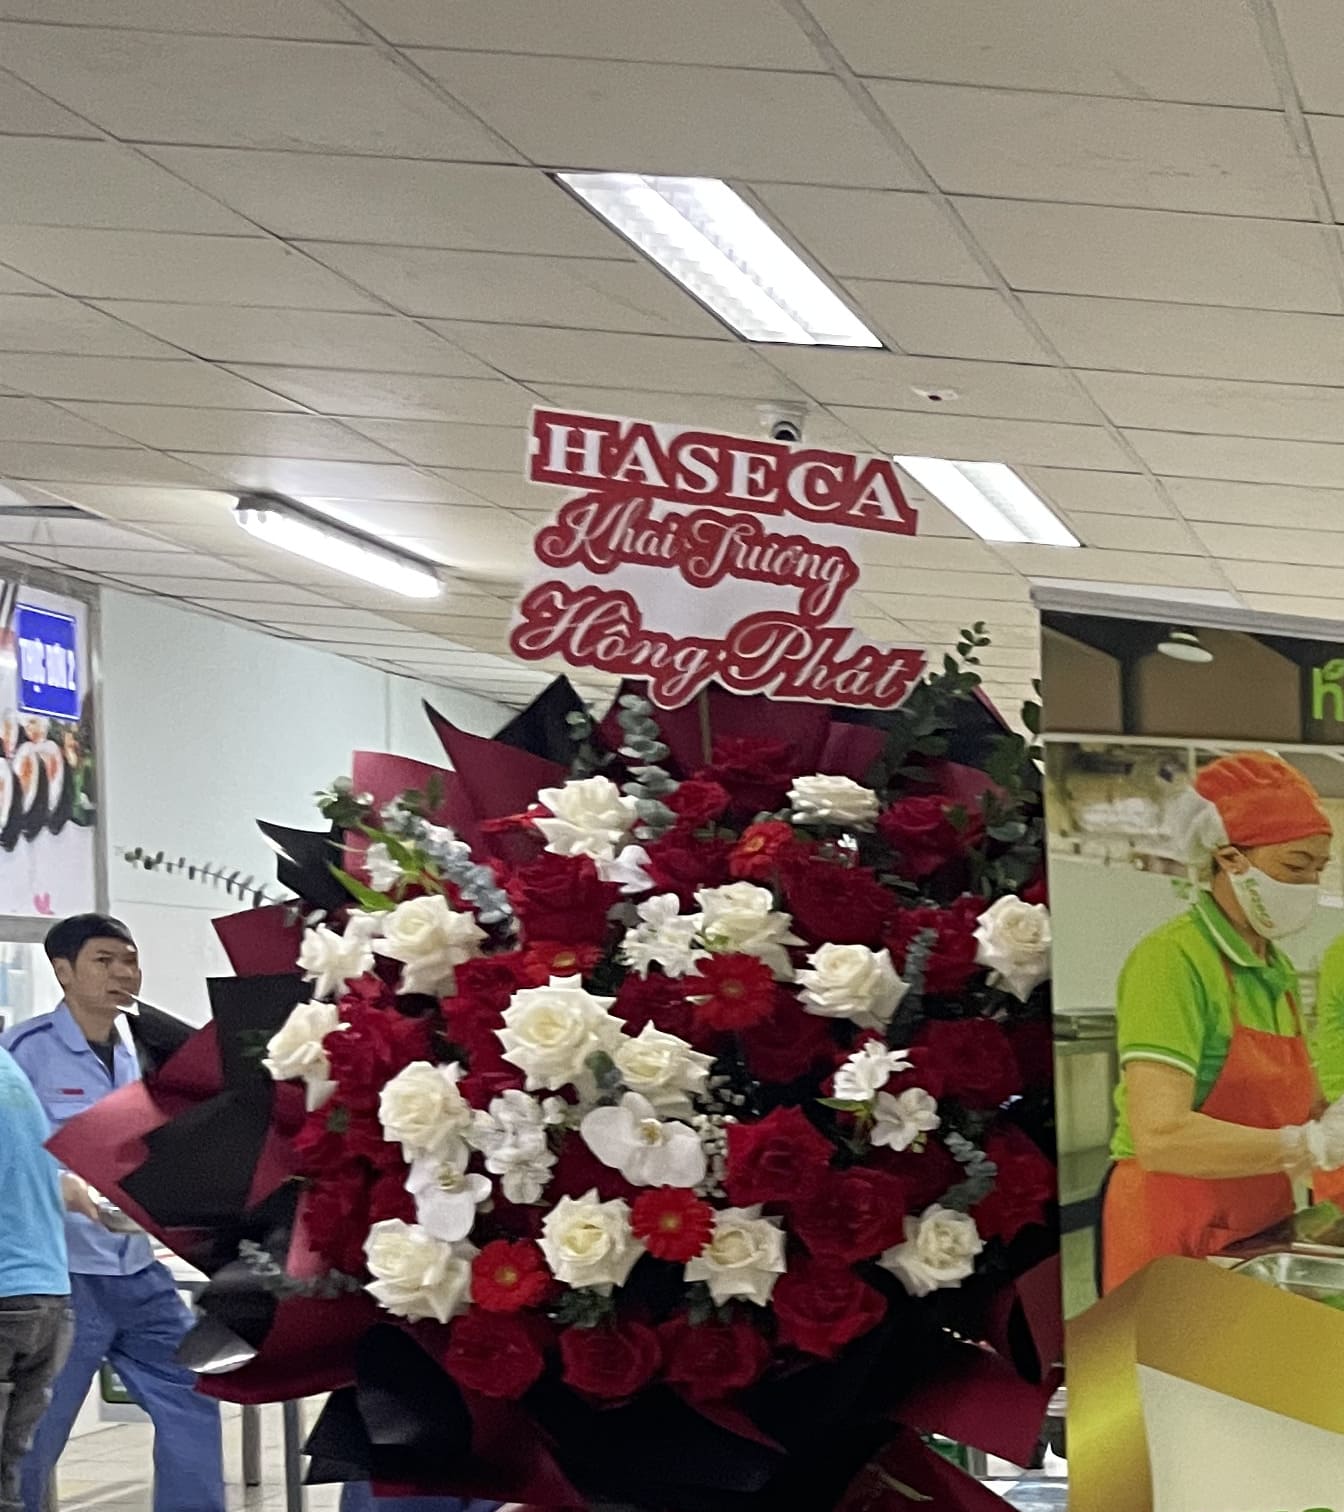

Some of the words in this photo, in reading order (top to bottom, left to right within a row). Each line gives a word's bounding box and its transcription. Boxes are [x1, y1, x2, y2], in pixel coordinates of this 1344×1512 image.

[544, 422, 906, 524] HASECA
[541, 496, 678, 566] Khai
[687, 518, 848, 614] Trương
[730, 621, 909, 699] Phát
